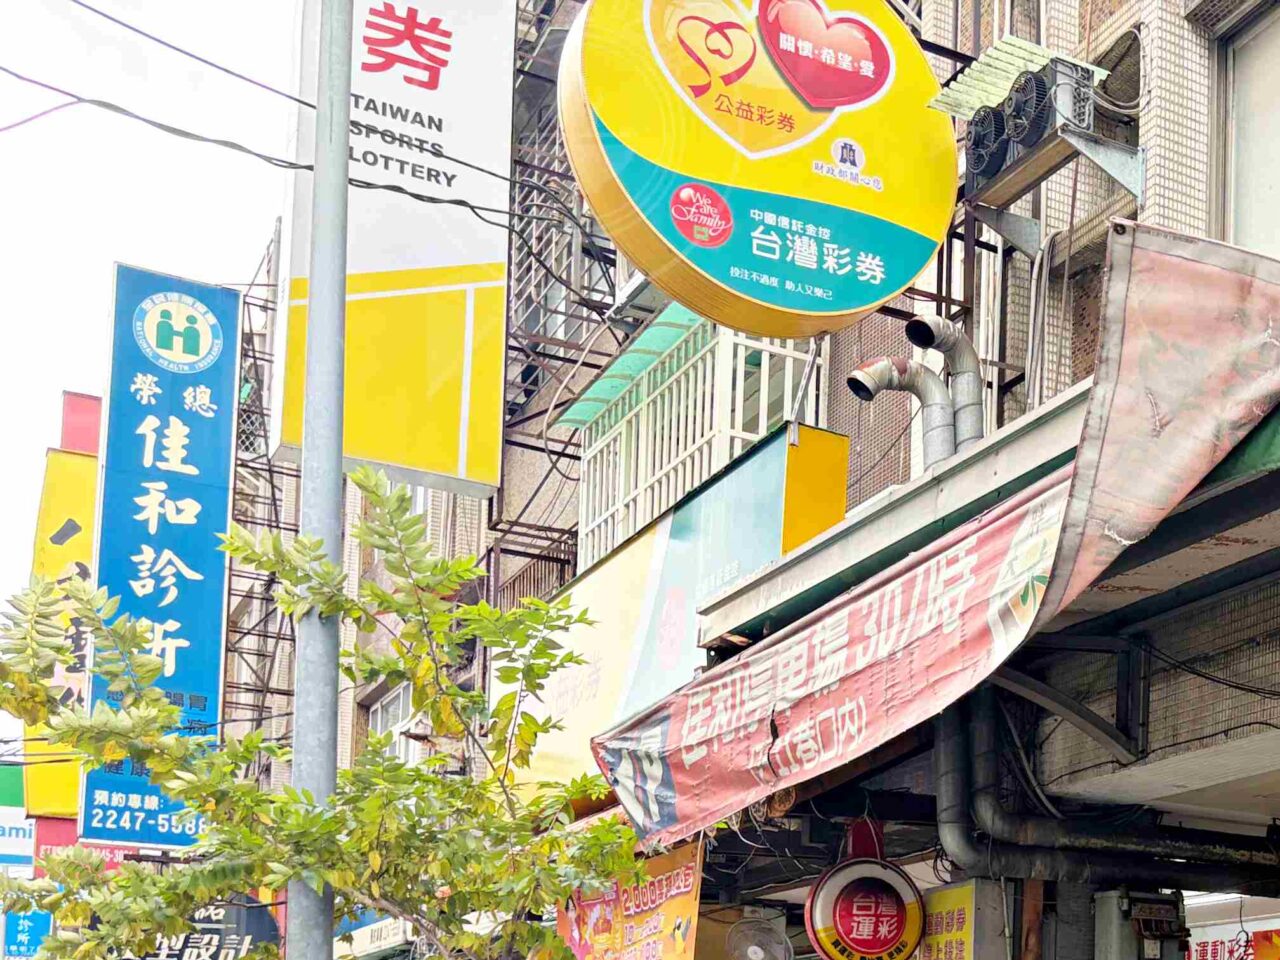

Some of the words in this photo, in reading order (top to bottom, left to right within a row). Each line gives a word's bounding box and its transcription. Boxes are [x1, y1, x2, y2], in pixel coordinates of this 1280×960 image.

[361, 0, 453, 91] 券
[351, 93, 444, 133] TAIWAN
[714, 93, 796, 134] 公益彩券
[350, 121, 444, 158] SPORTS
[349, 146, 457, 188] LOTTERY
[671, 205, 732, 236] Family
[750, 209, 831, 239] 中國信託金控
[750, 227, 886, 285] 台灣彩券
[129, 371, 218, 419] 榮總
[130, 416, 203, 677] 佳和診所
[849, 916, 898, 940] 運彩
